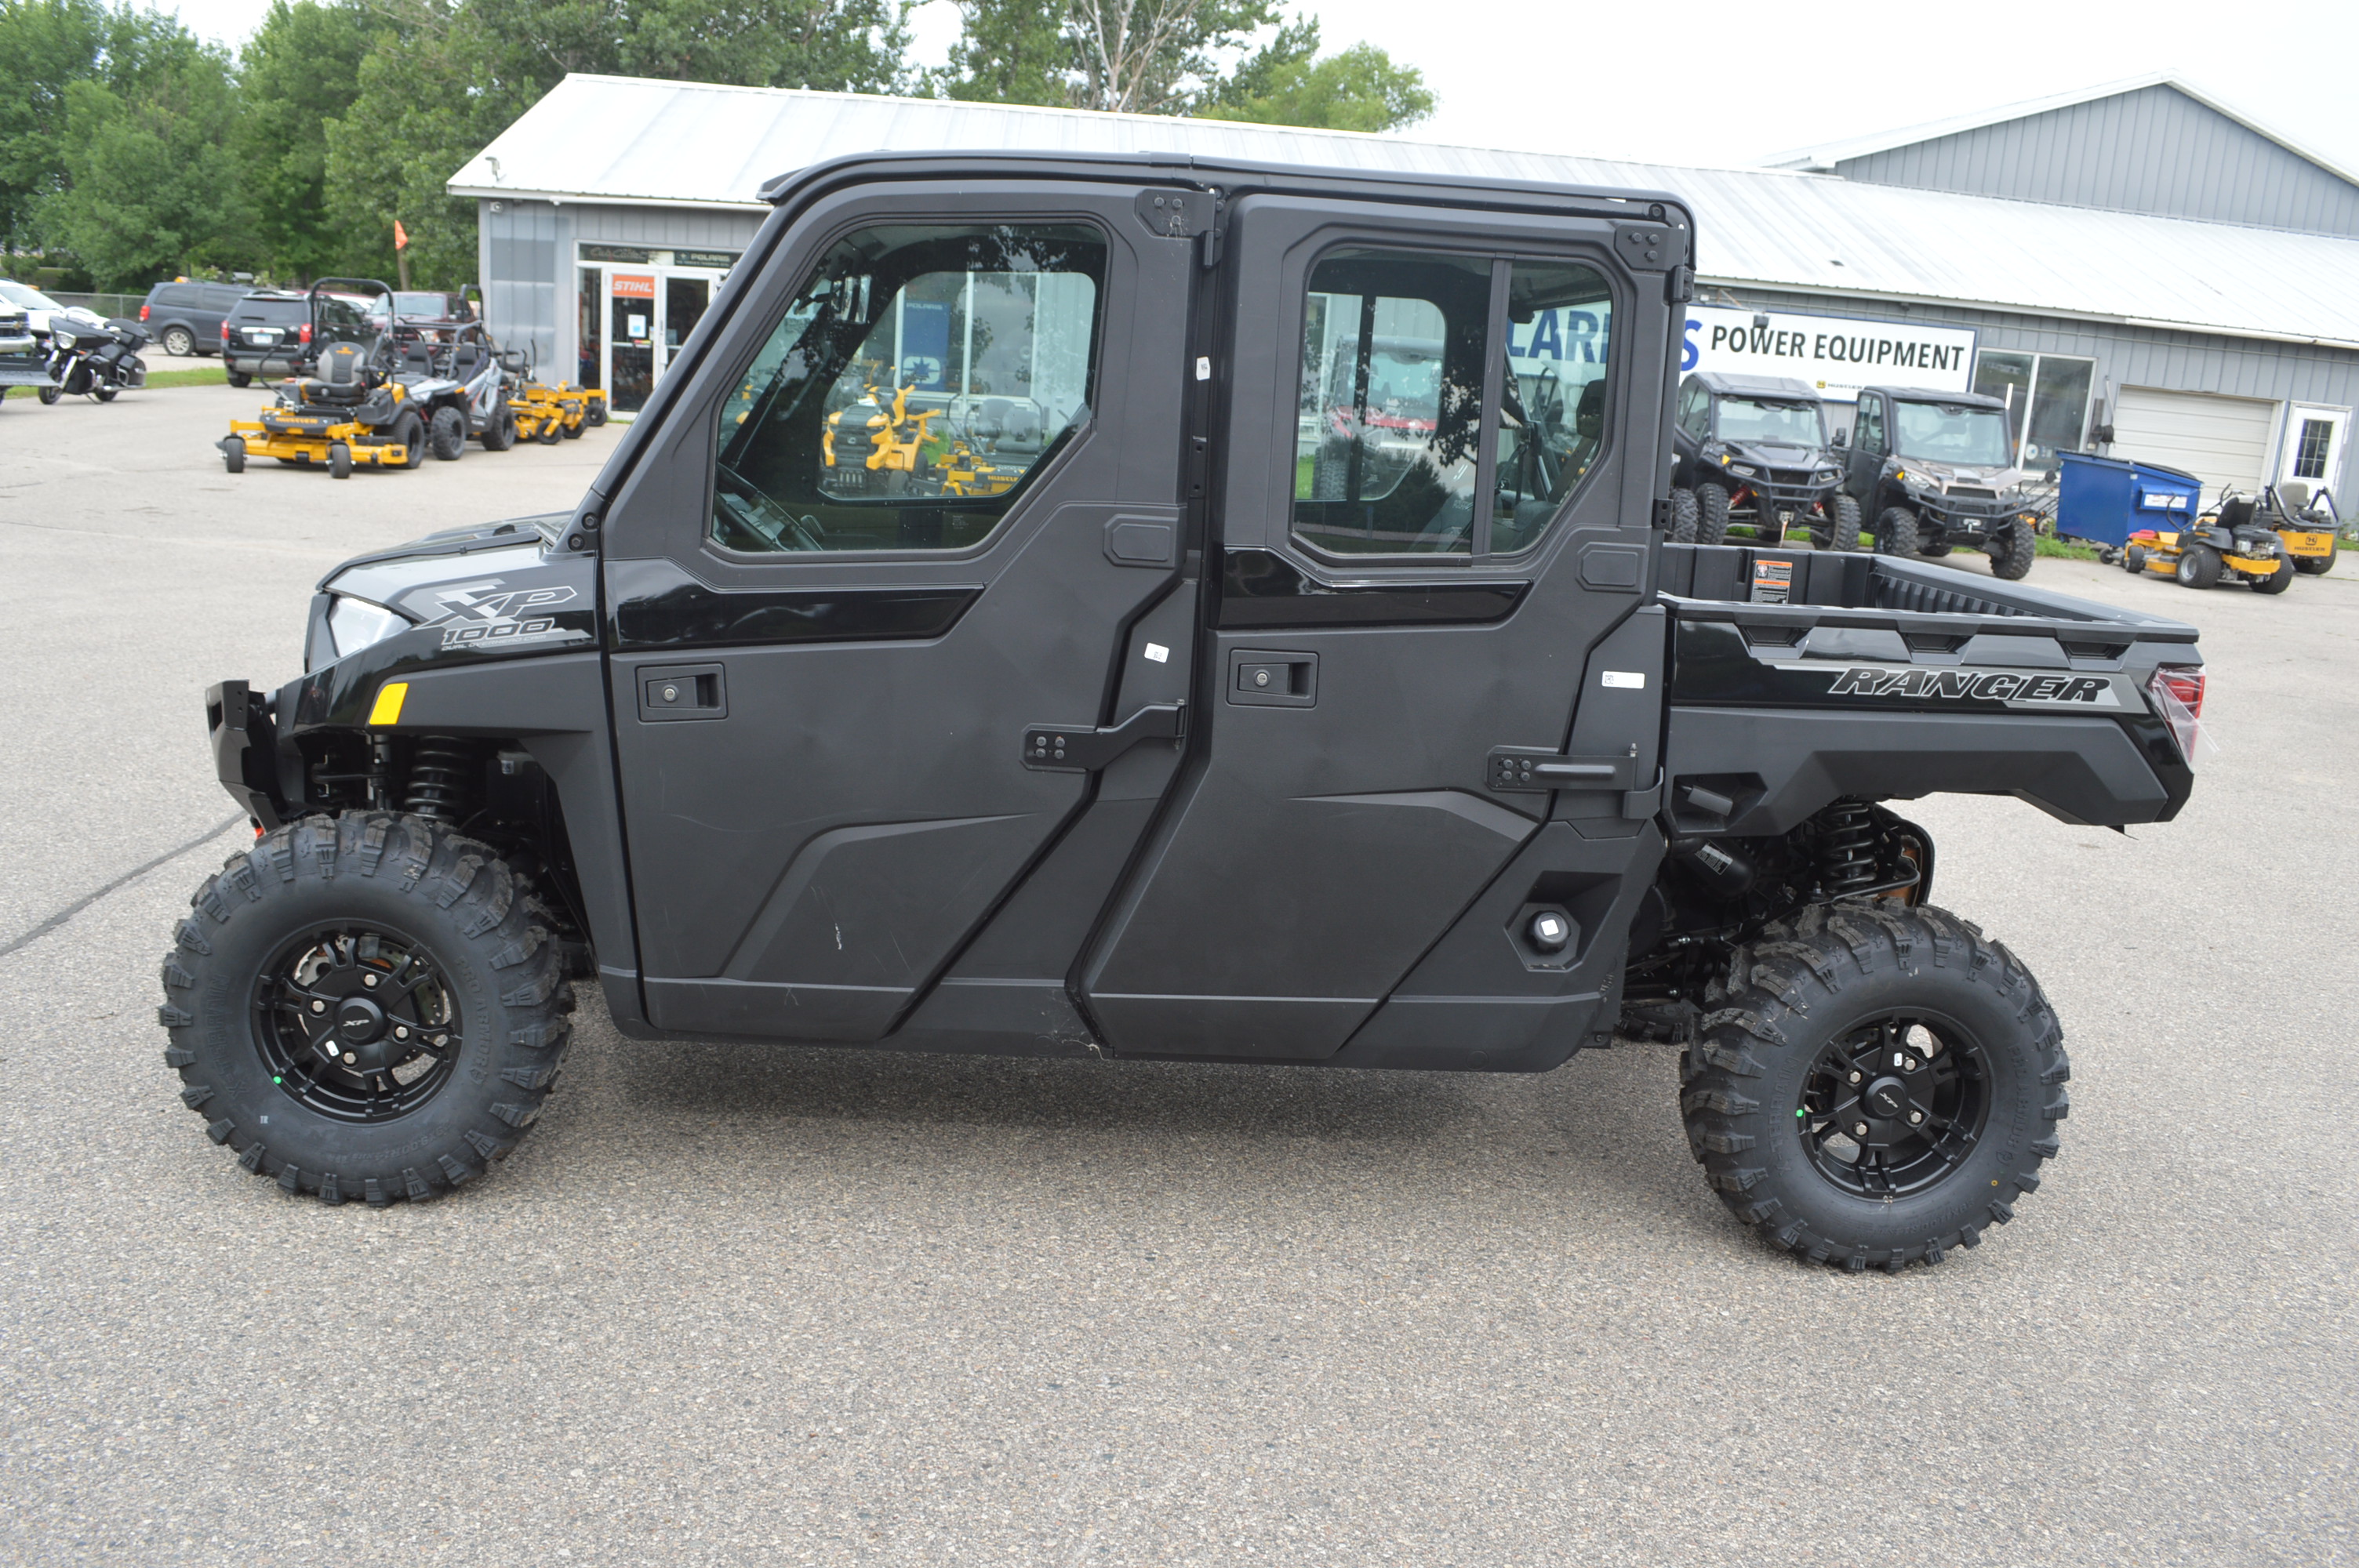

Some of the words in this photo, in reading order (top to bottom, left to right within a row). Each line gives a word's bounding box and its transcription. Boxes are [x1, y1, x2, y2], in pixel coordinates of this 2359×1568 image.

[690, 253, 730, 263] POLARIS
[612, 281, 653, 292] STIHL
[1711, 325, 1807, 358] POWER
[1813, 333, 1965, 372] EQUIPMENT
[409, 586, 578, 631] XP
[441, 617, 555, 646] 1000
[1827, 666, 2112, 703] RANGER
[342, 1018, 371, 1027] XP
[454, 954, 481, 993] PRO
[474, 996, 491, 1067] ARMOR
[206, 973, 251, 1100] X-TERRAIN
[1768, 1054, 1800, 1177] X-TERRAIN
[1878, 1092, 1899, 1109] XP
